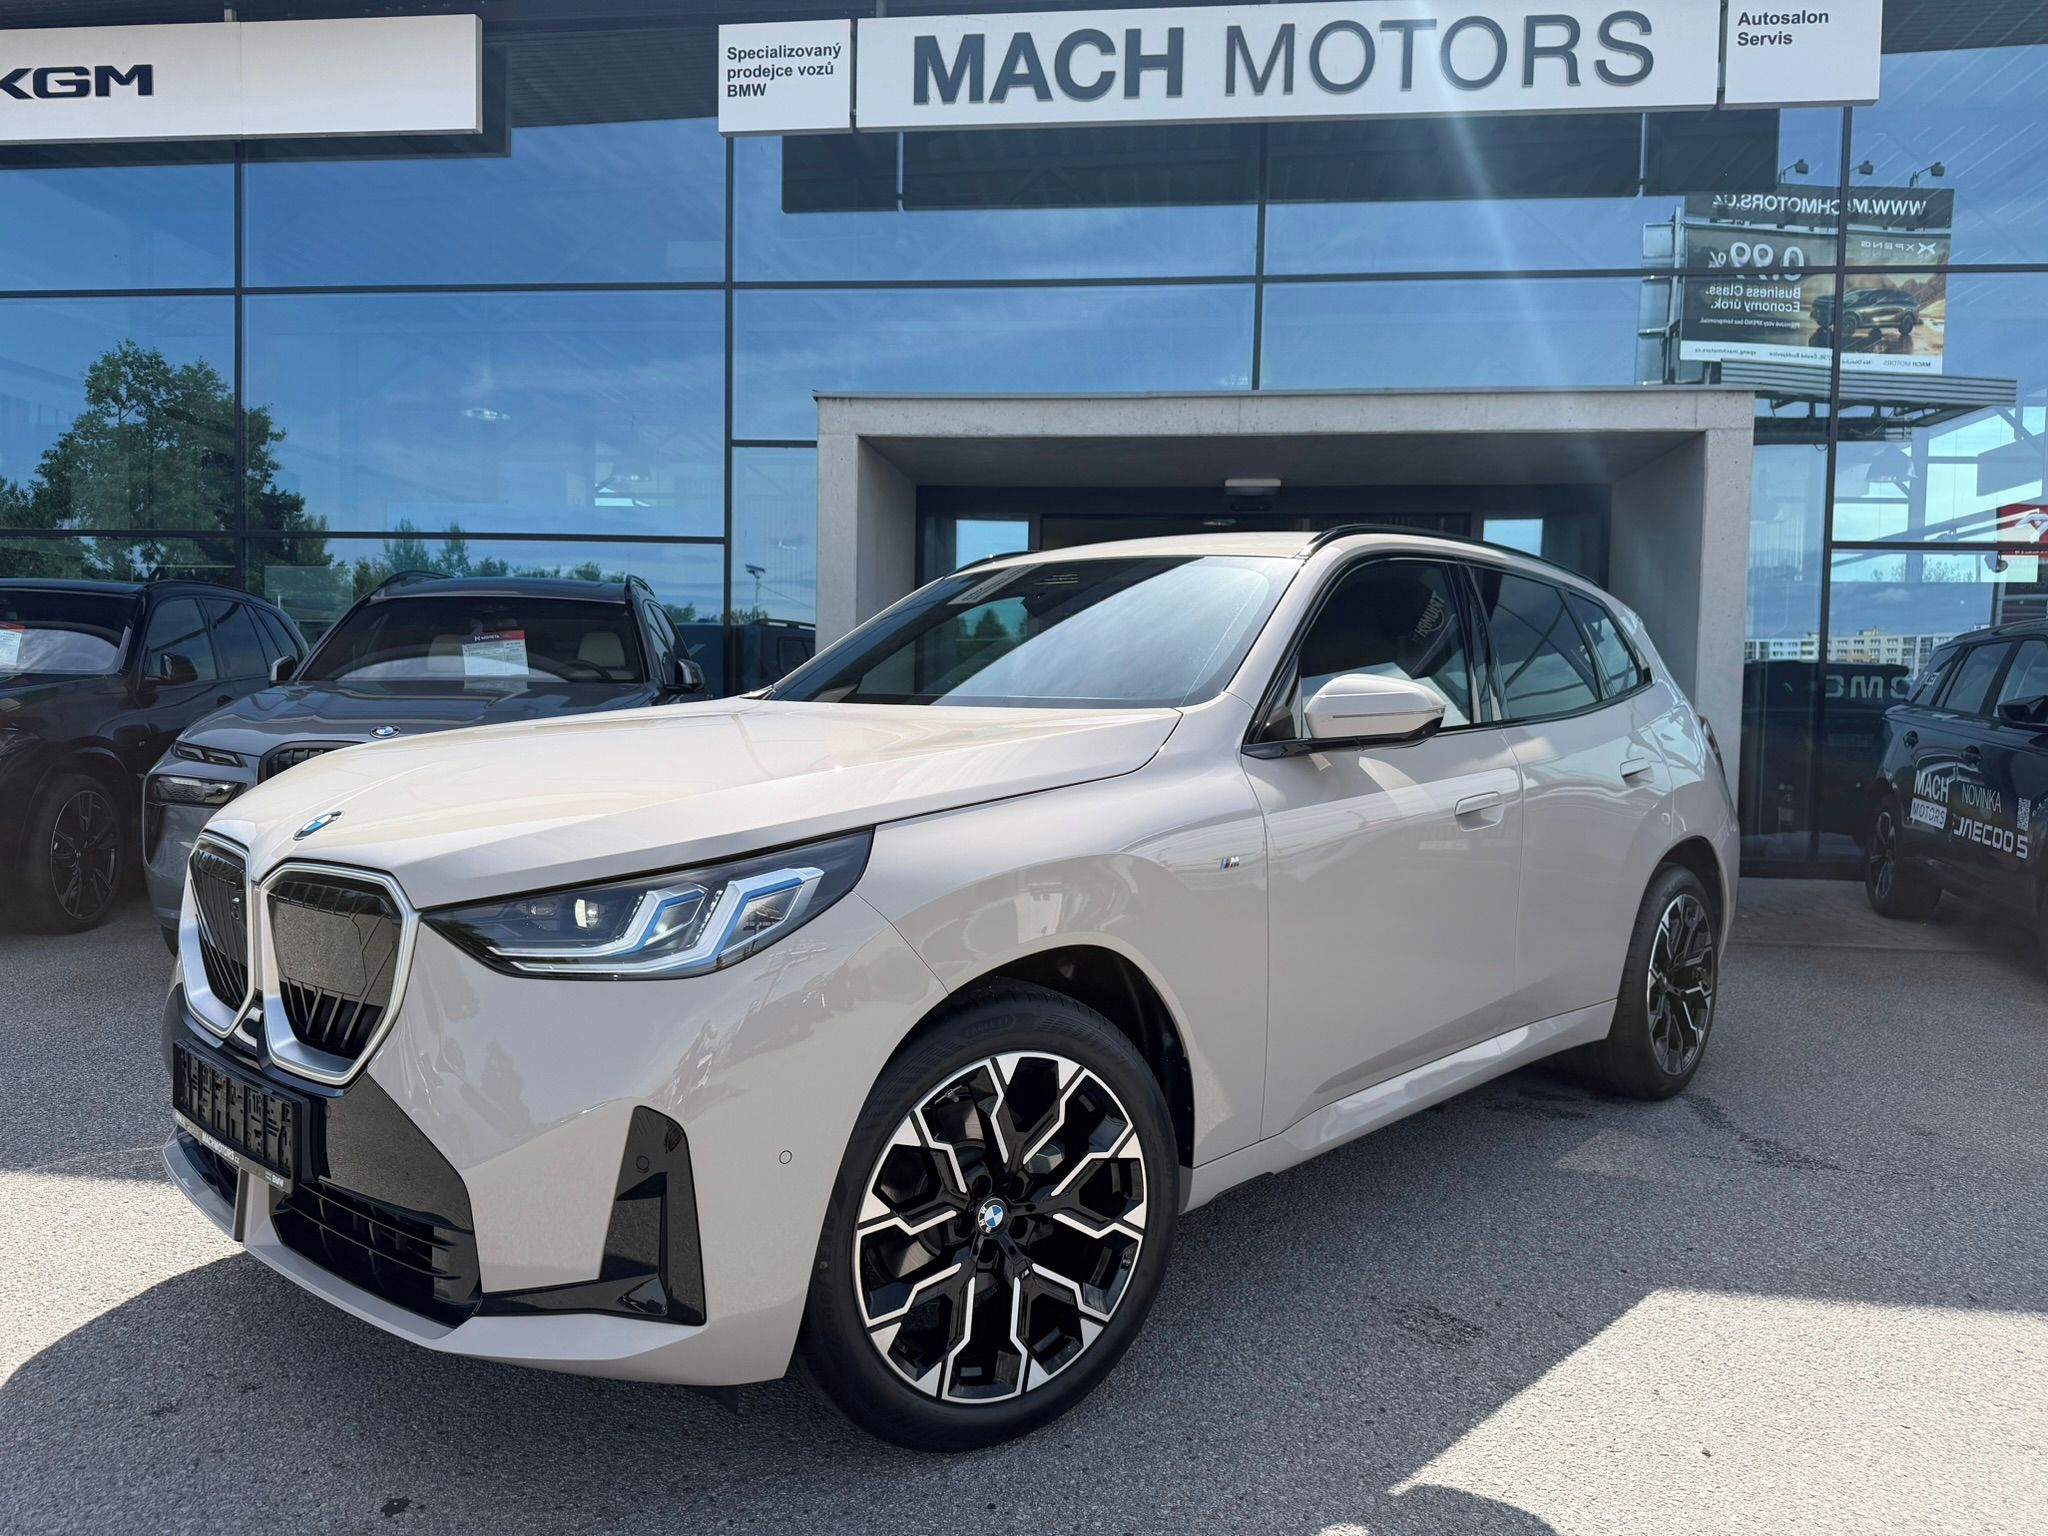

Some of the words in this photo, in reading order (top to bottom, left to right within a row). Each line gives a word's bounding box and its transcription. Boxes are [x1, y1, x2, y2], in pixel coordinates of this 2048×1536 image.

[1737, 10, 1830, 27] Autosalon
[1737, 30, 1793, 47] Servis
[726, 42, 842, 62] Specializovaný
[913, 26, 1184, 105] MACH
[1225, 10, 1655, 97] MOTORS
[0, 64, 154, 100] KGM
[726, 64, 794, 84] prodejce
[797, 61, 835, 77] vozů
[726, 82, 767, 98] BMW
[1913, 769, 1949, 803] MACH
[1961, 783, 2002, 813] NOVINKA
[1912, 802, 1945, 825] MOTORS
[2016, 834, 2029, 859] 5
